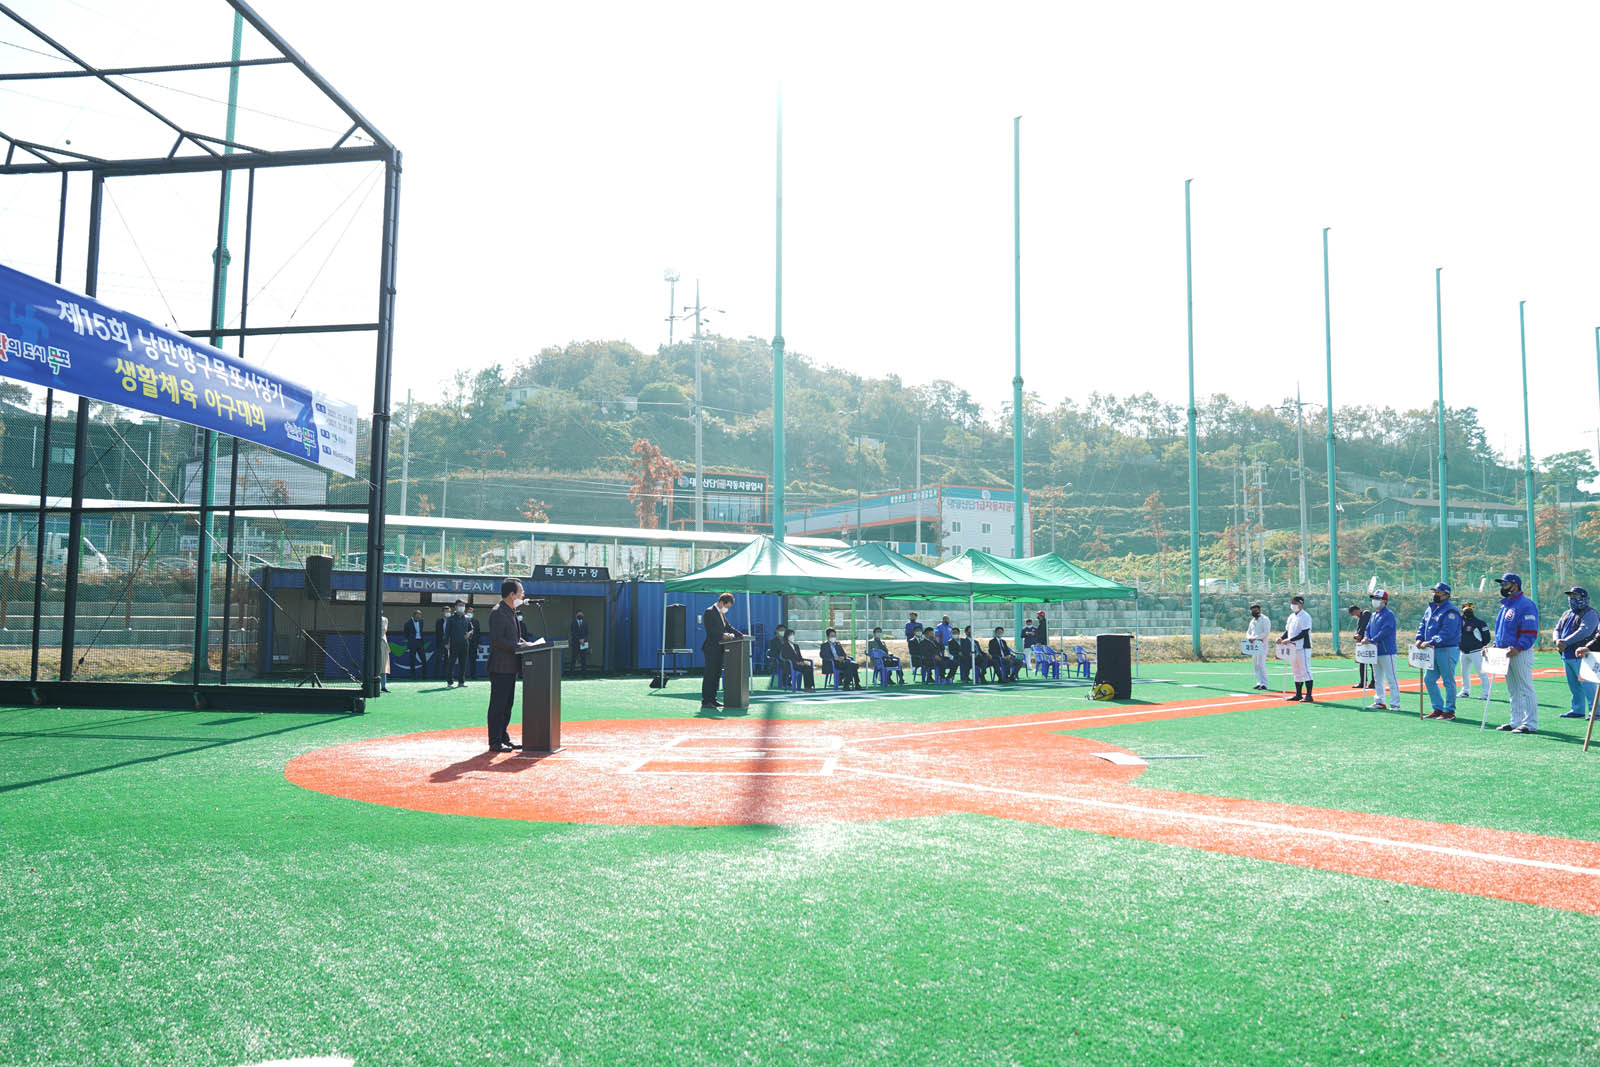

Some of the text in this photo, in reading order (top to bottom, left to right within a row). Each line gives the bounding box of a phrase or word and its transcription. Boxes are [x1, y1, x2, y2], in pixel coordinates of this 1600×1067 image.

[23, 341, 46, 363] 도시
[56, 299, 286, 409] 제15회 낭만항구목포시장기
[115, 358, 198, 409] 생활체육
[204, 388, 266, 432] 야구대회
[544, 567, 599, 578] 목포야구장
[400, 578, 495, 592] HOME TEAM
